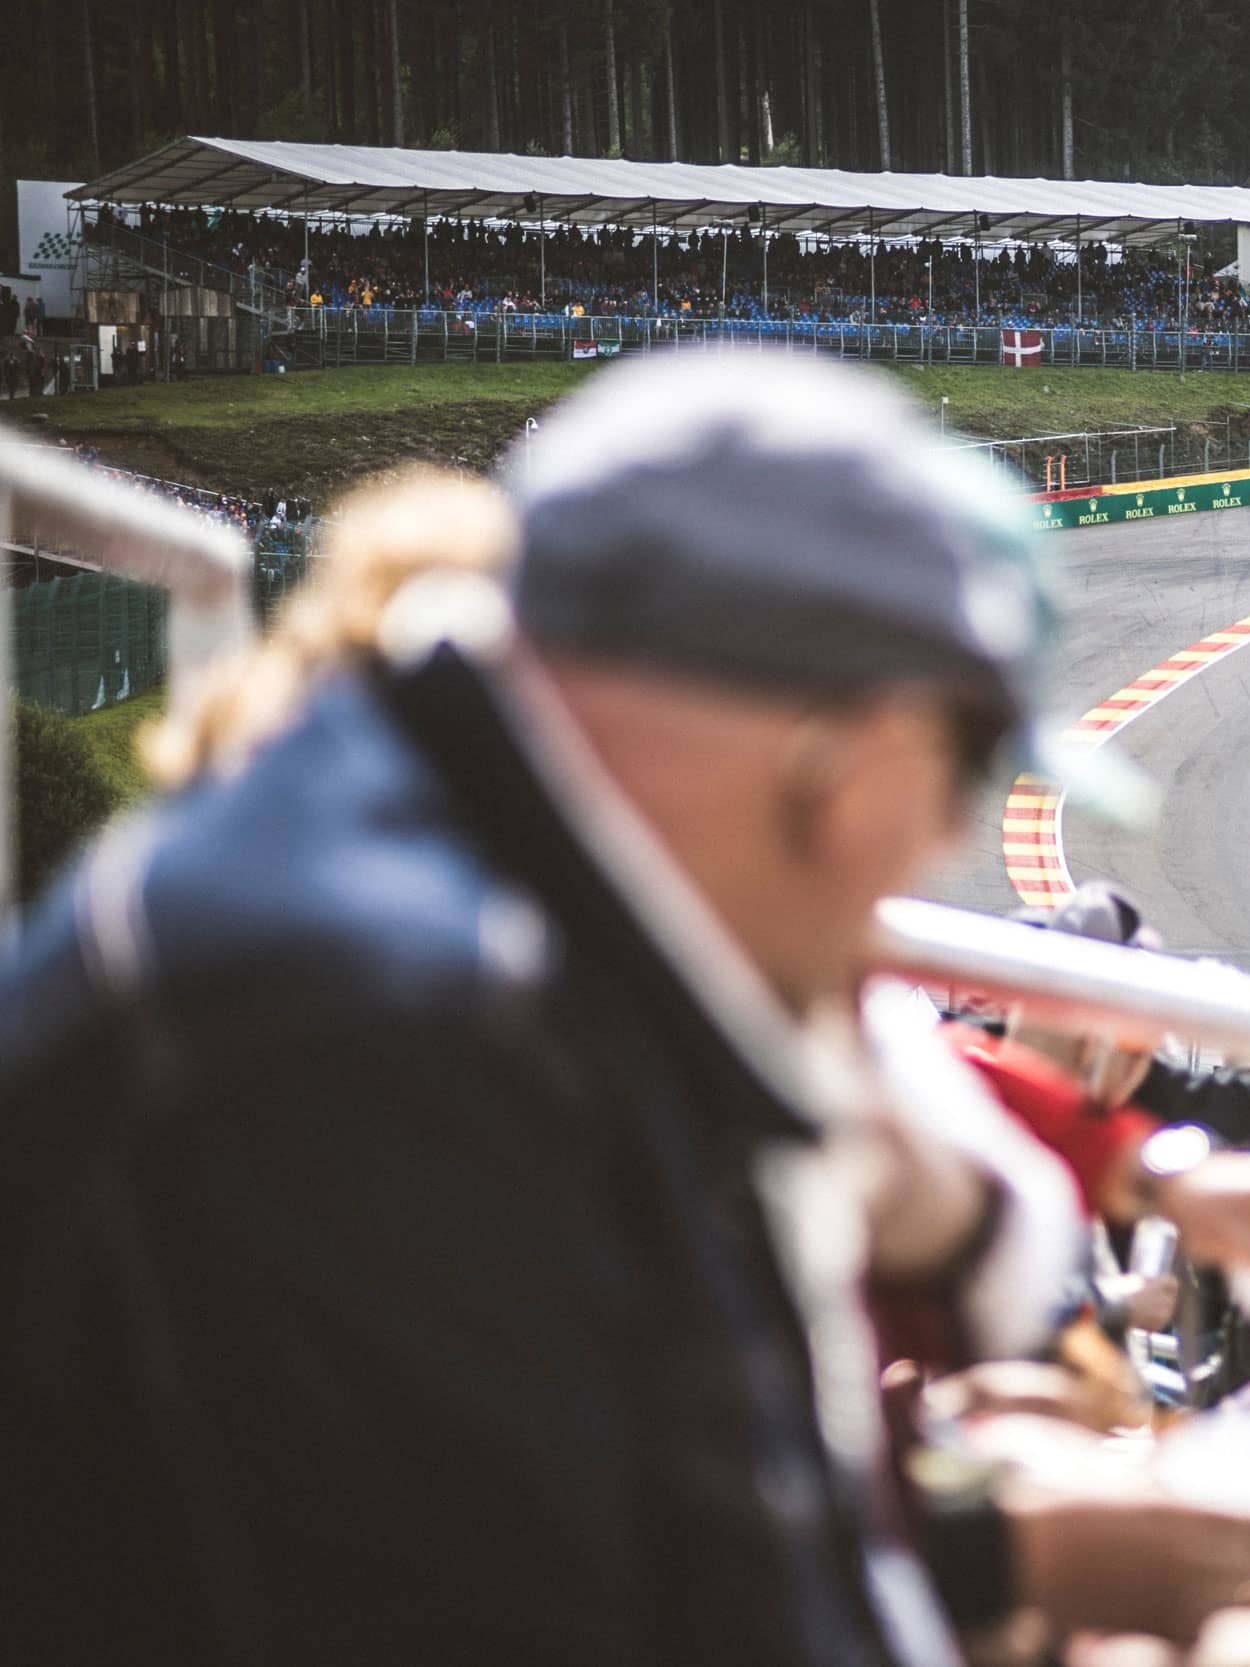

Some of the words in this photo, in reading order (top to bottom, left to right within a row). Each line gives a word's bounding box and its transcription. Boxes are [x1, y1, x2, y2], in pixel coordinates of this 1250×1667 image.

[1168, 502, 1196, 513] ROLEX
[1213, 497, 1242, 509] ROLEX
[1079, 512, 1109, 524] ROLEX
[1126, 507, 1154, 519] ROLEX
